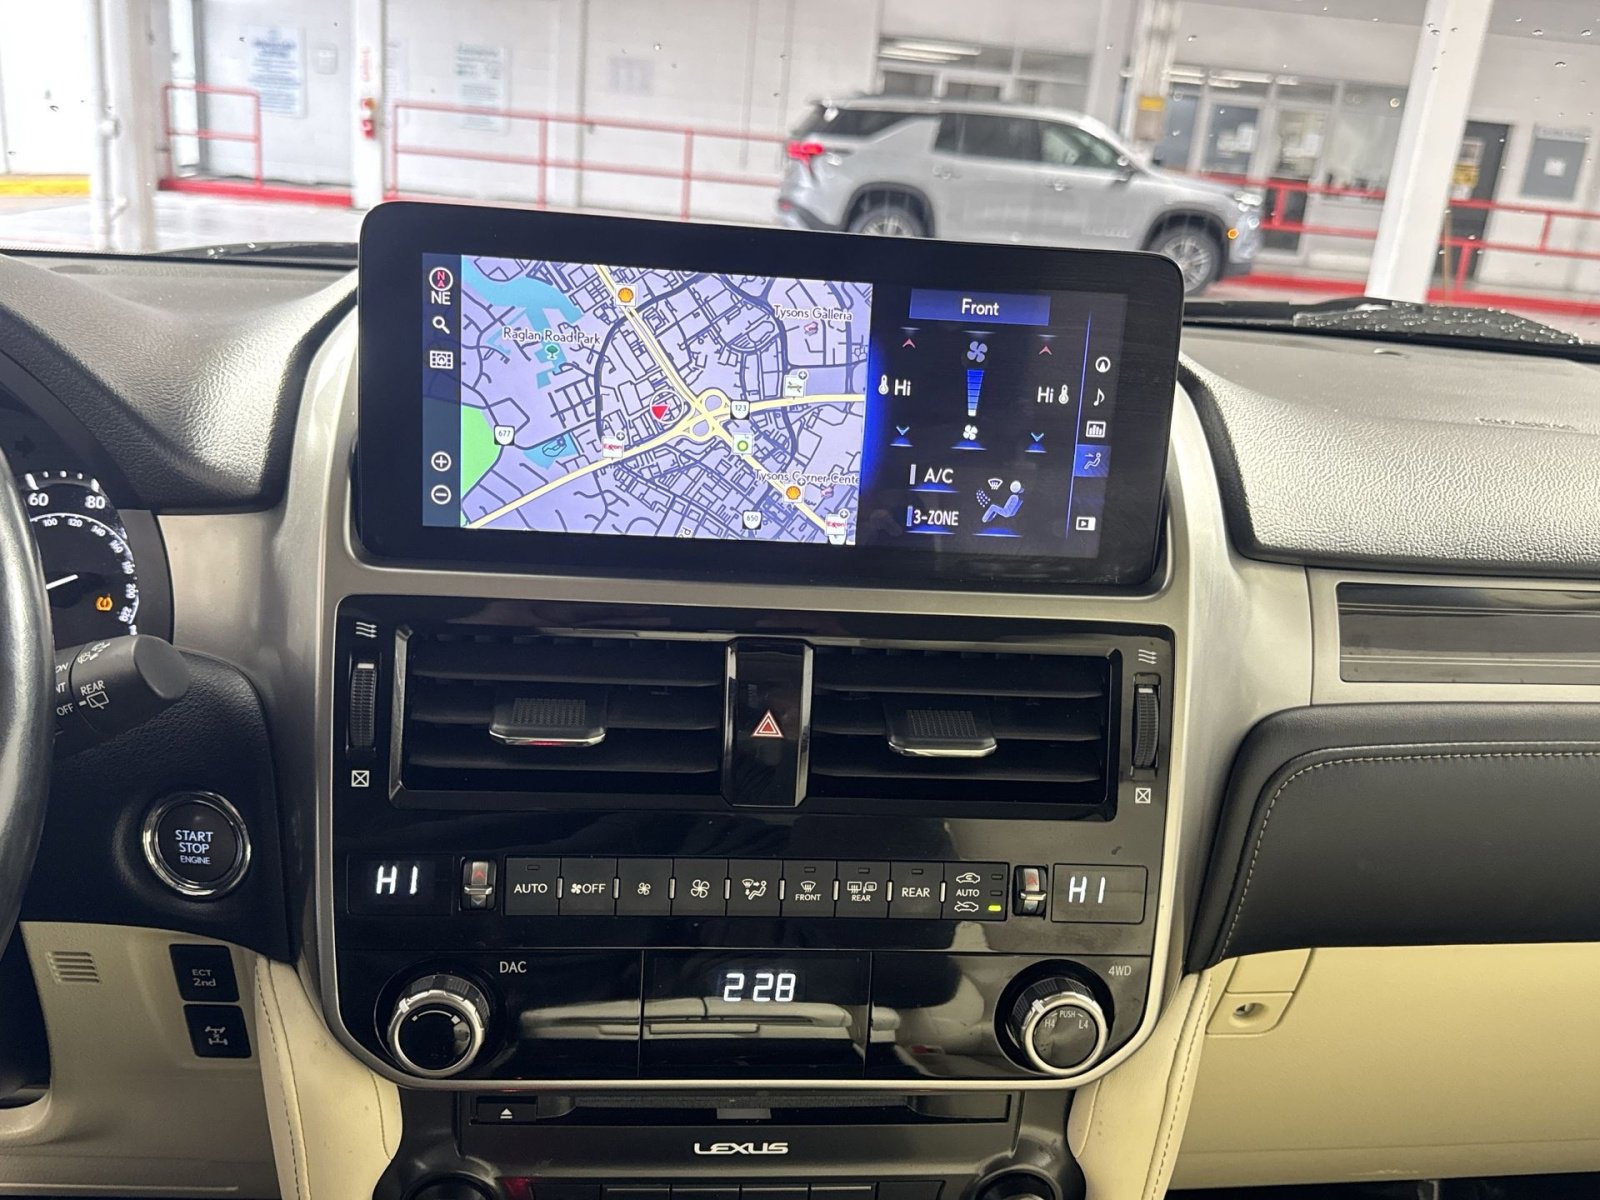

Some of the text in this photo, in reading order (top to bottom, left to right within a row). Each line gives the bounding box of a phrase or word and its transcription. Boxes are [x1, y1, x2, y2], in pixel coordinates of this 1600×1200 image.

[430, 290, 452, 305] NE
[774, 304, 852, 321] Tysons Galleria
[961, 298, 1000, 316] Front
[503, 326, 601, 344] Raglan Road Park
[894, 379, 911, 397] Hi
[1037, 386, 1054, 403] Hi
[735, 404, 747, 412] 123
[498, 429, 511, 438] 677
[755, 468, 789, 483] Tysons
[792, 470, 829, 483] Crner
[924, 468, 954, 484] A/C
[28, 493, 49, 507] 60
[85, 496, 106, 509] 80
[42, 518, 58, 527] 100
[67, 518, 83, 528] 120
[913, 510, 959, 526] 3-ZONE
[90, 525, 106, 537] 140
[80, 680, 106, 696] REAR
[56, 703, 74, 716] OFF
[175, 829, 214, 842] START
[179, 842, 210, 854] STOP
[180, 855, 211, 865] ENGINE
[375, 865, 418, 895] HI
[513, 883, 548, 894] AUTO
[582, 884, 606, 894] OFF
[901, 887, 930, 898] REAR
[956, 889, 980, 897] AUTO
[1068, 876, 1106, 904] HI
[795, 893, 822, 902] FRONT
[851, 894, 871, 902] REAR
[191, 969, 212, 977] ECT
[499, 961, 527, 974] DAC
[1108, 965, 1132, 976] 4WD
[193, 978, 217, 987] 2nd
[1059, 1010, 1076, 1019] PUSH
[1044, 1019, 1056, 1029] H4
[1078, 1019, 1089, 1029] L4
[693, 1142, 789, 1155] LEXUS
